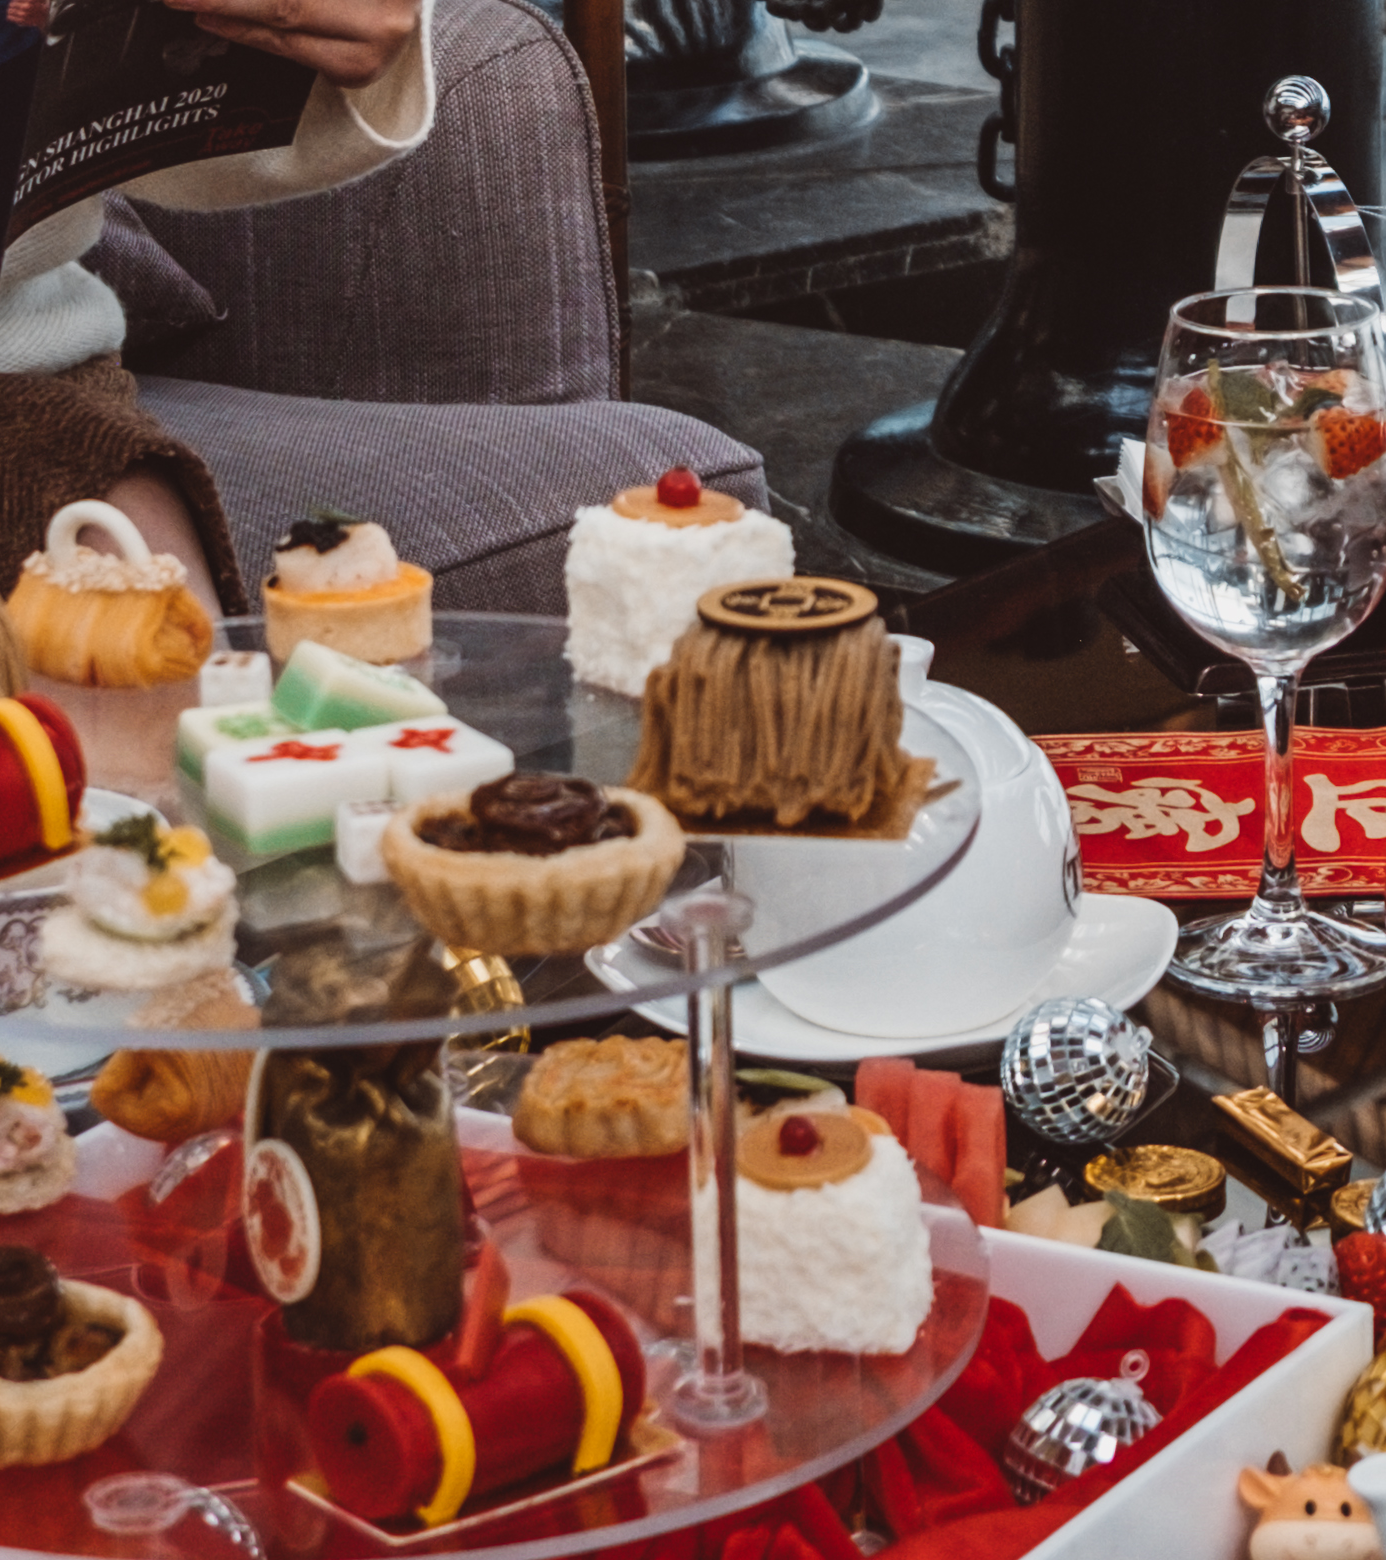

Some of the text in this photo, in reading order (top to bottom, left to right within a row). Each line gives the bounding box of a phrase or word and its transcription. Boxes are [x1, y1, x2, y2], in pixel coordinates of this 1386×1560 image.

[44, 95, 170, 161] SHANGHAI
[175, 82, 228, 108] 2020
[70, 104, 222, 166] HIGHLIGHTS
